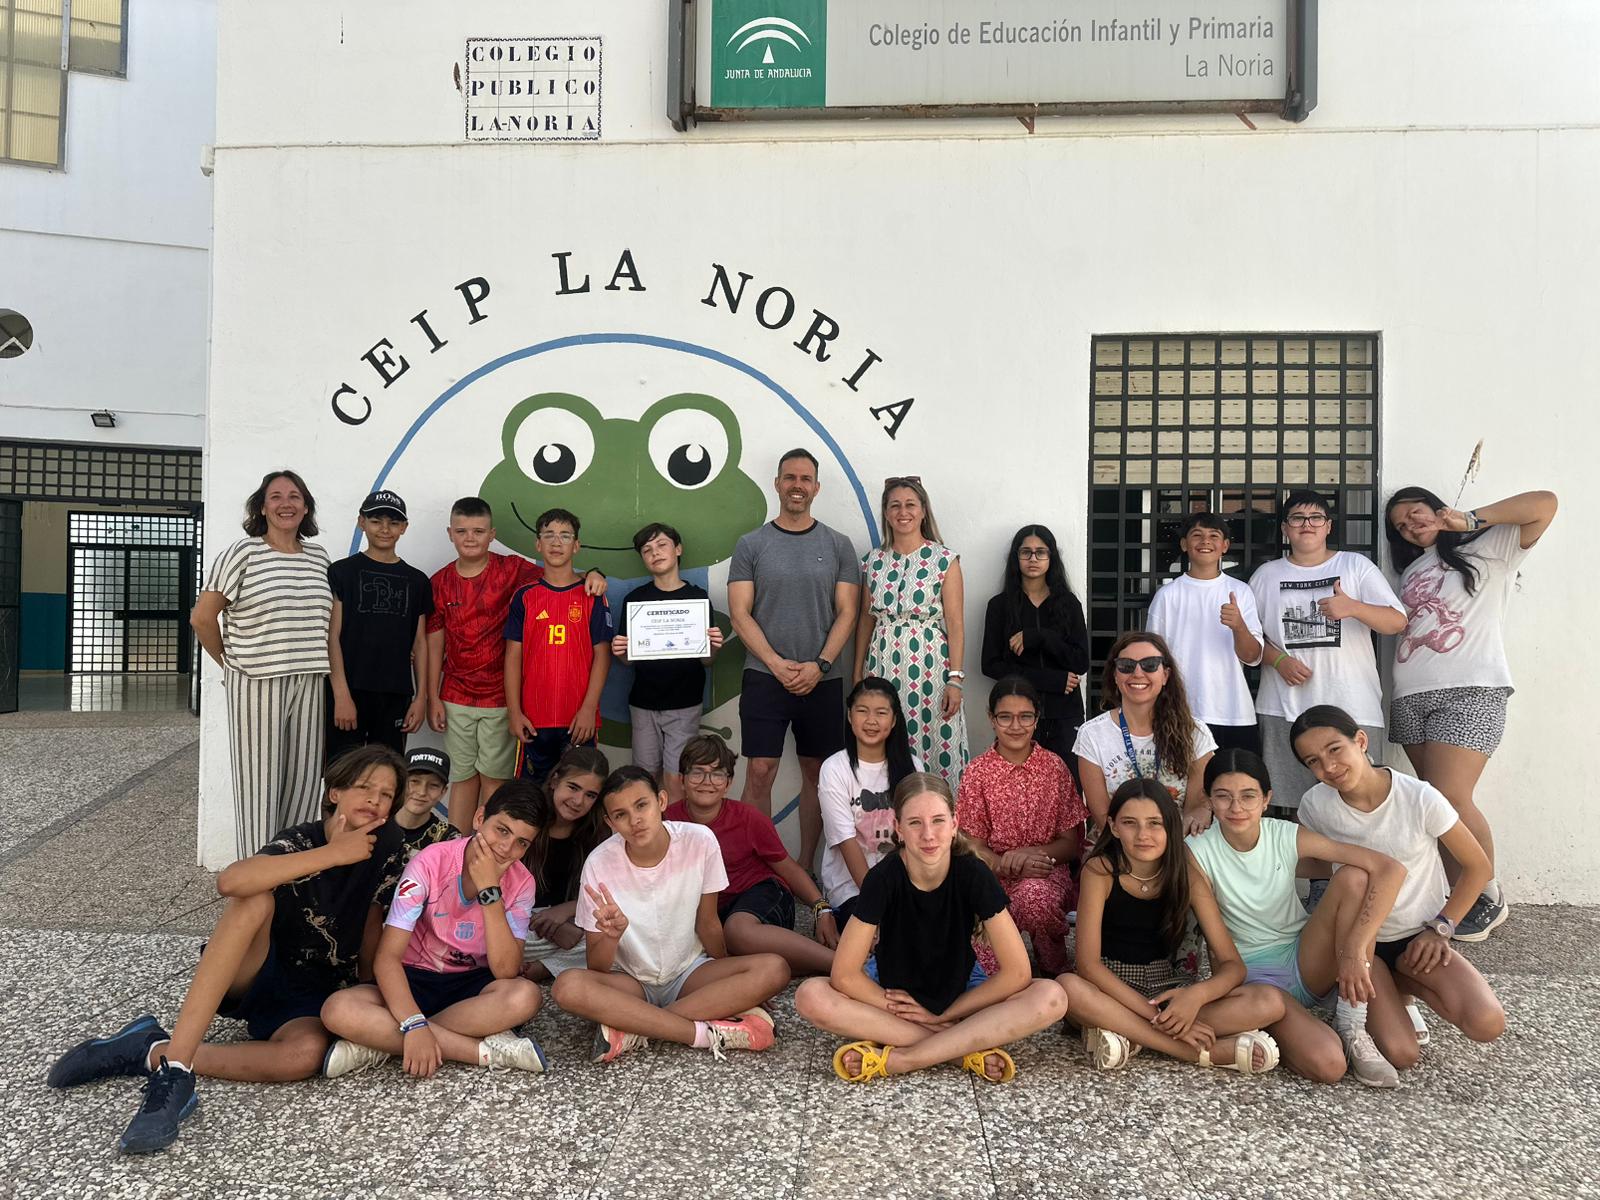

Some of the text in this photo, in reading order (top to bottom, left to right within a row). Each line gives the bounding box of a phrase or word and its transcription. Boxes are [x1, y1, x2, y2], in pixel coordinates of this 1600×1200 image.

[869, 16, 1274, 51] Colegio de Educación Infantil y Primaria
[471, 45, 596, 62] COLEGIO
[724, 68, 812, 79] JUNTA DE ANDALUCIA
[1185, 53, 1274, 78] La Noria
[471, 79, 596, 96] PUBLICO
[331, 247, 916, 439] CEIP LA NORIA
[548, 624, 566, 645] 19
[410, 753, 443, 766] FORTNITE
